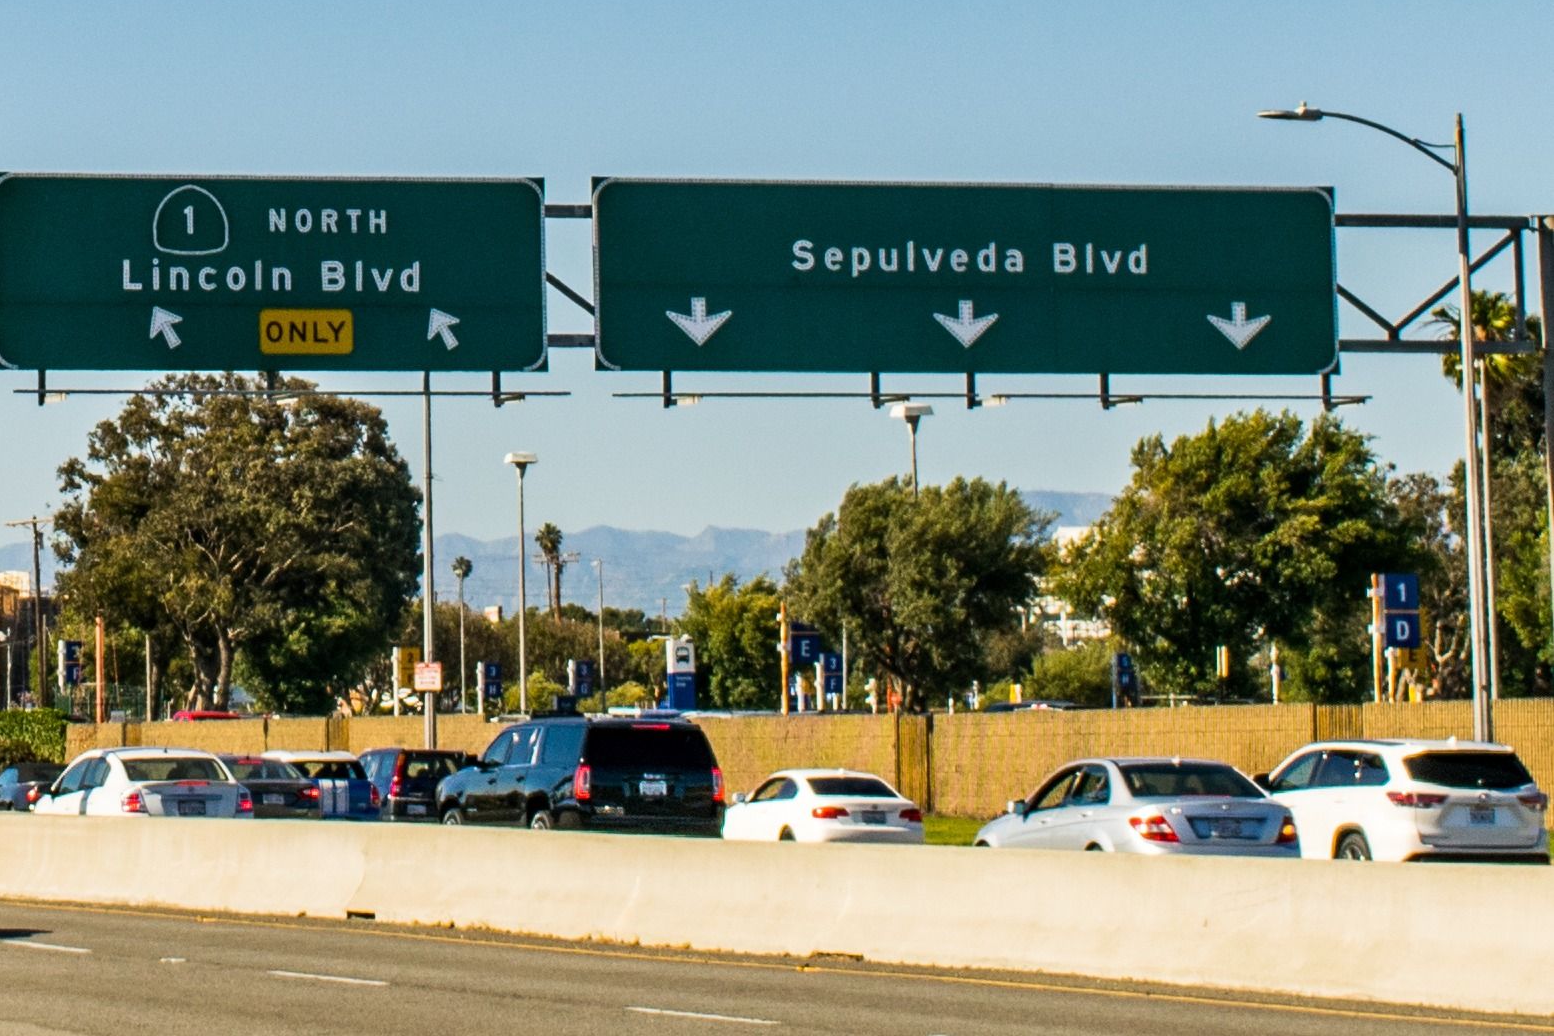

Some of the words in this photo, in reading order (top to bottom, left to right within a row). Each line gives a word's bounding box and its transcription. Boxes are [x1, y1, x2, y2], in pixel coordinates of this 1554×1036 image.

[183, 205, 195, 235] 1
[268, 207, 388, 234] NORTH
[791, 239, 1026, 277] Sepulveda
[1052, 241, 1149, 275] Blvd
[122, 259, 293, 292] Lincoln
[320, 260, 421, 293] Blvd
[265, 320, 347, 344] ONLY
[1397, 582, 1406, 603] 1
[1397, 620, 1410, 641] D
[801, 640, 811, 657] E
